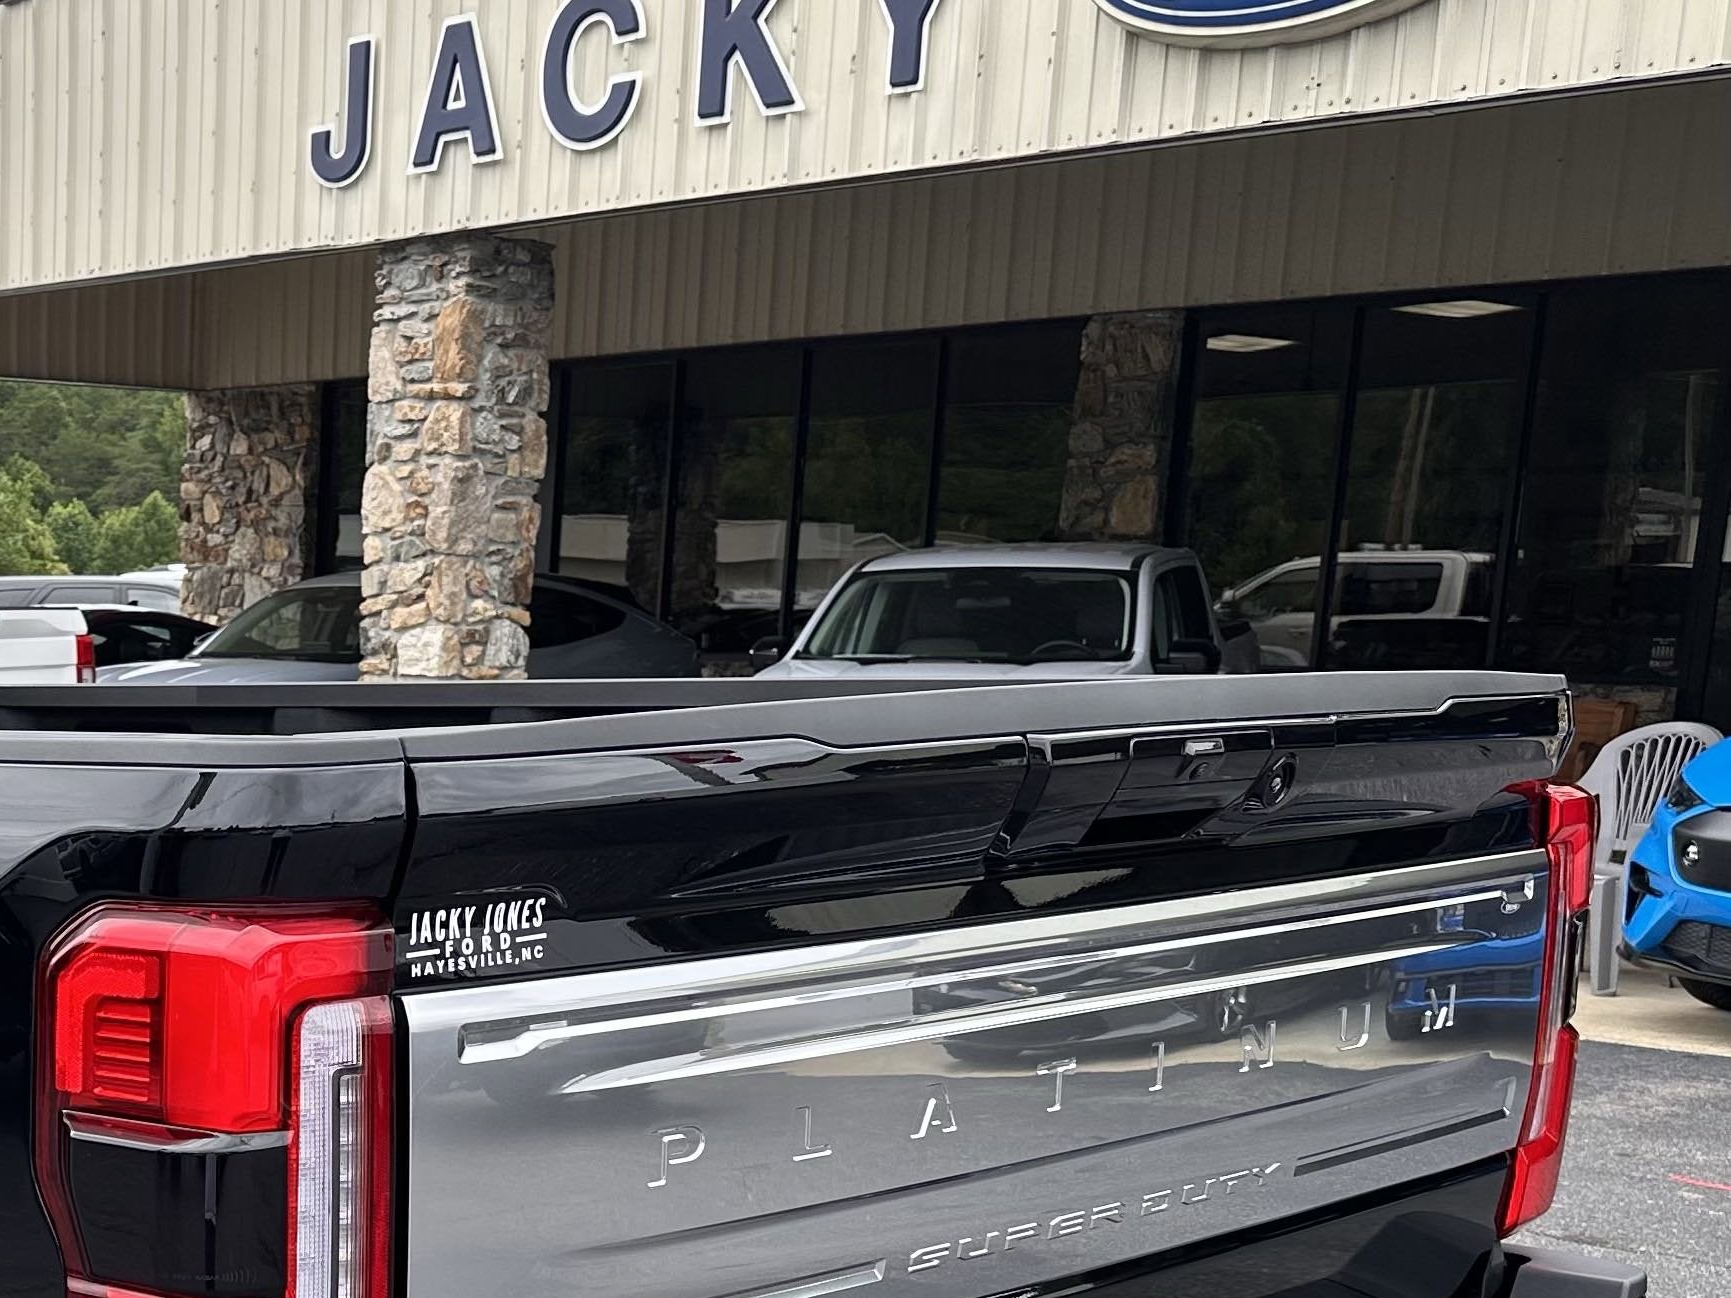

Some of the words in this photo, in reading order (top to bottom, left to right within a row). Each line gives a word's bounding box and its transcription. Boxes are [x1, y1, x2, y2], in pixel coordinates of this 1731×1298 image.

[308, 0, 939, 189] JACKY
[408, 904, 476, 946] JACKY
[482, 896, 548, 935] JONES
[444, 931, 512, 958] FORD
[647, 982, 1460, 1189] PLATINUM
[907, 1201, 1126, 1274] SUPER
[1140, 1162, 1281, 1216] DUTY
